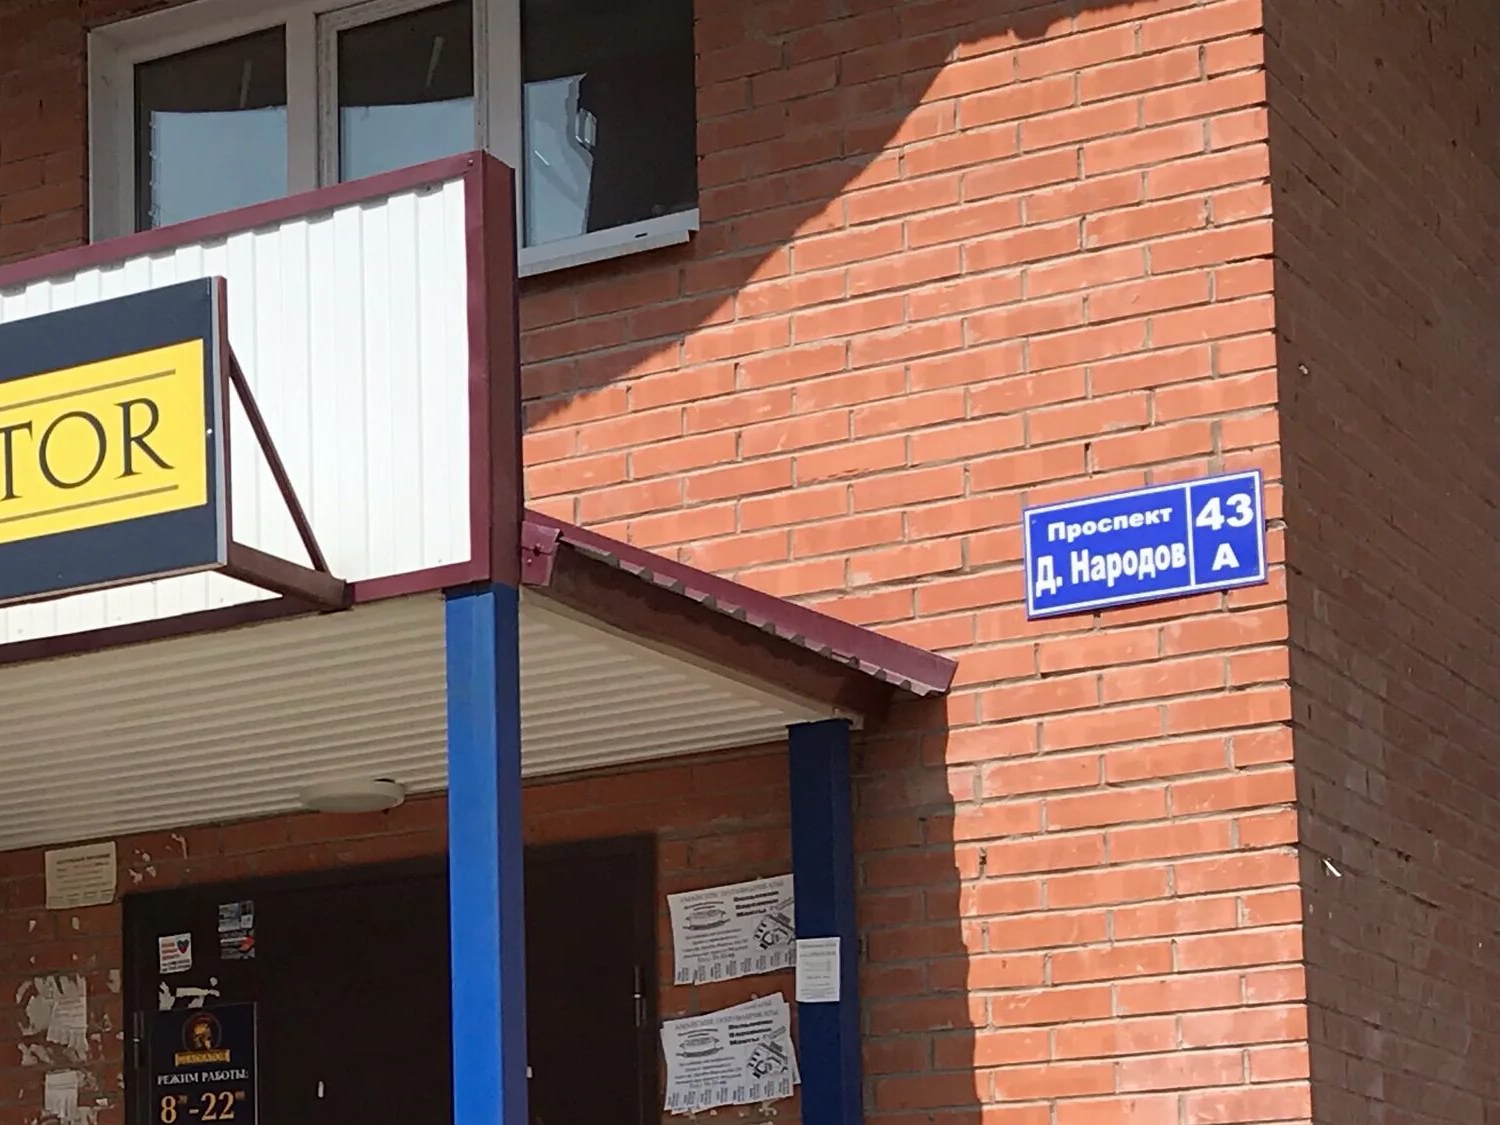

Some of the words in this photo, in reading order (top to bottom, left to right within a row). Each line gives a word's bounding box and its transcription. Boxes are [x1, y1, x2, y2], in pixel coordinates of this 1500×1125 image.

[1047, 507, 1173, 543] Проспект
[1195, 493, 1255, 531] 43
[1035, 555, 1064, 598] Д.
[1070, 542, 1187, 588] Народов
[1211, 543, 1240, 571] А
[157, 1072, 199, 1086] РЕЖИМ
